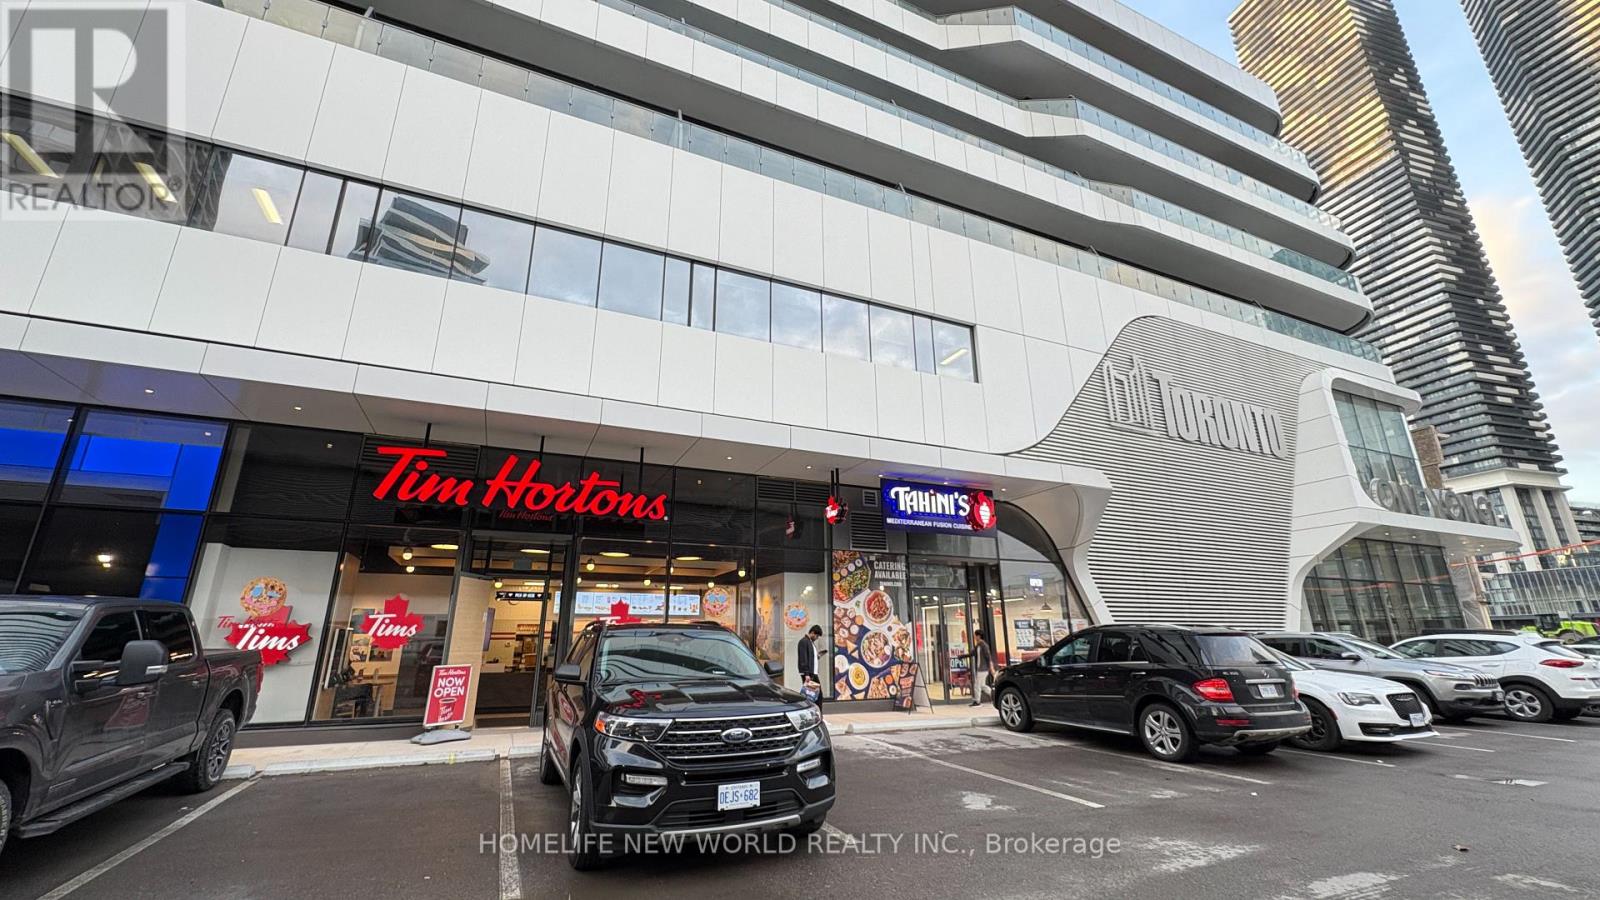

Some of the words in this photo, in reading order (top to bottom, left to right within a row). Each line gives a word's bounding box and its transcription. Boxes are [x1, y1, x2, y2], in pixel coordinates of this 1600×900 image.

[1152, 370, 1288, 459] TORONTO
[372, 446, 475, 506] Tim
[481, 454, 668, 521] Hortons
[886, 517, 932, 527] MEDITERRANEAN
[933, 521, 952, 529] FUSION
[873, 561, 906, 571] CATERING
[874, 571, 907, 580] AVAILABLE
[366, 613, 418, 637] Tims
[236, 622, 300, 650] Tims
[437, 677, 465, 687] NOW
[434, 686, 465, 698] OPEN
[743, 788, 759, 801] 682
